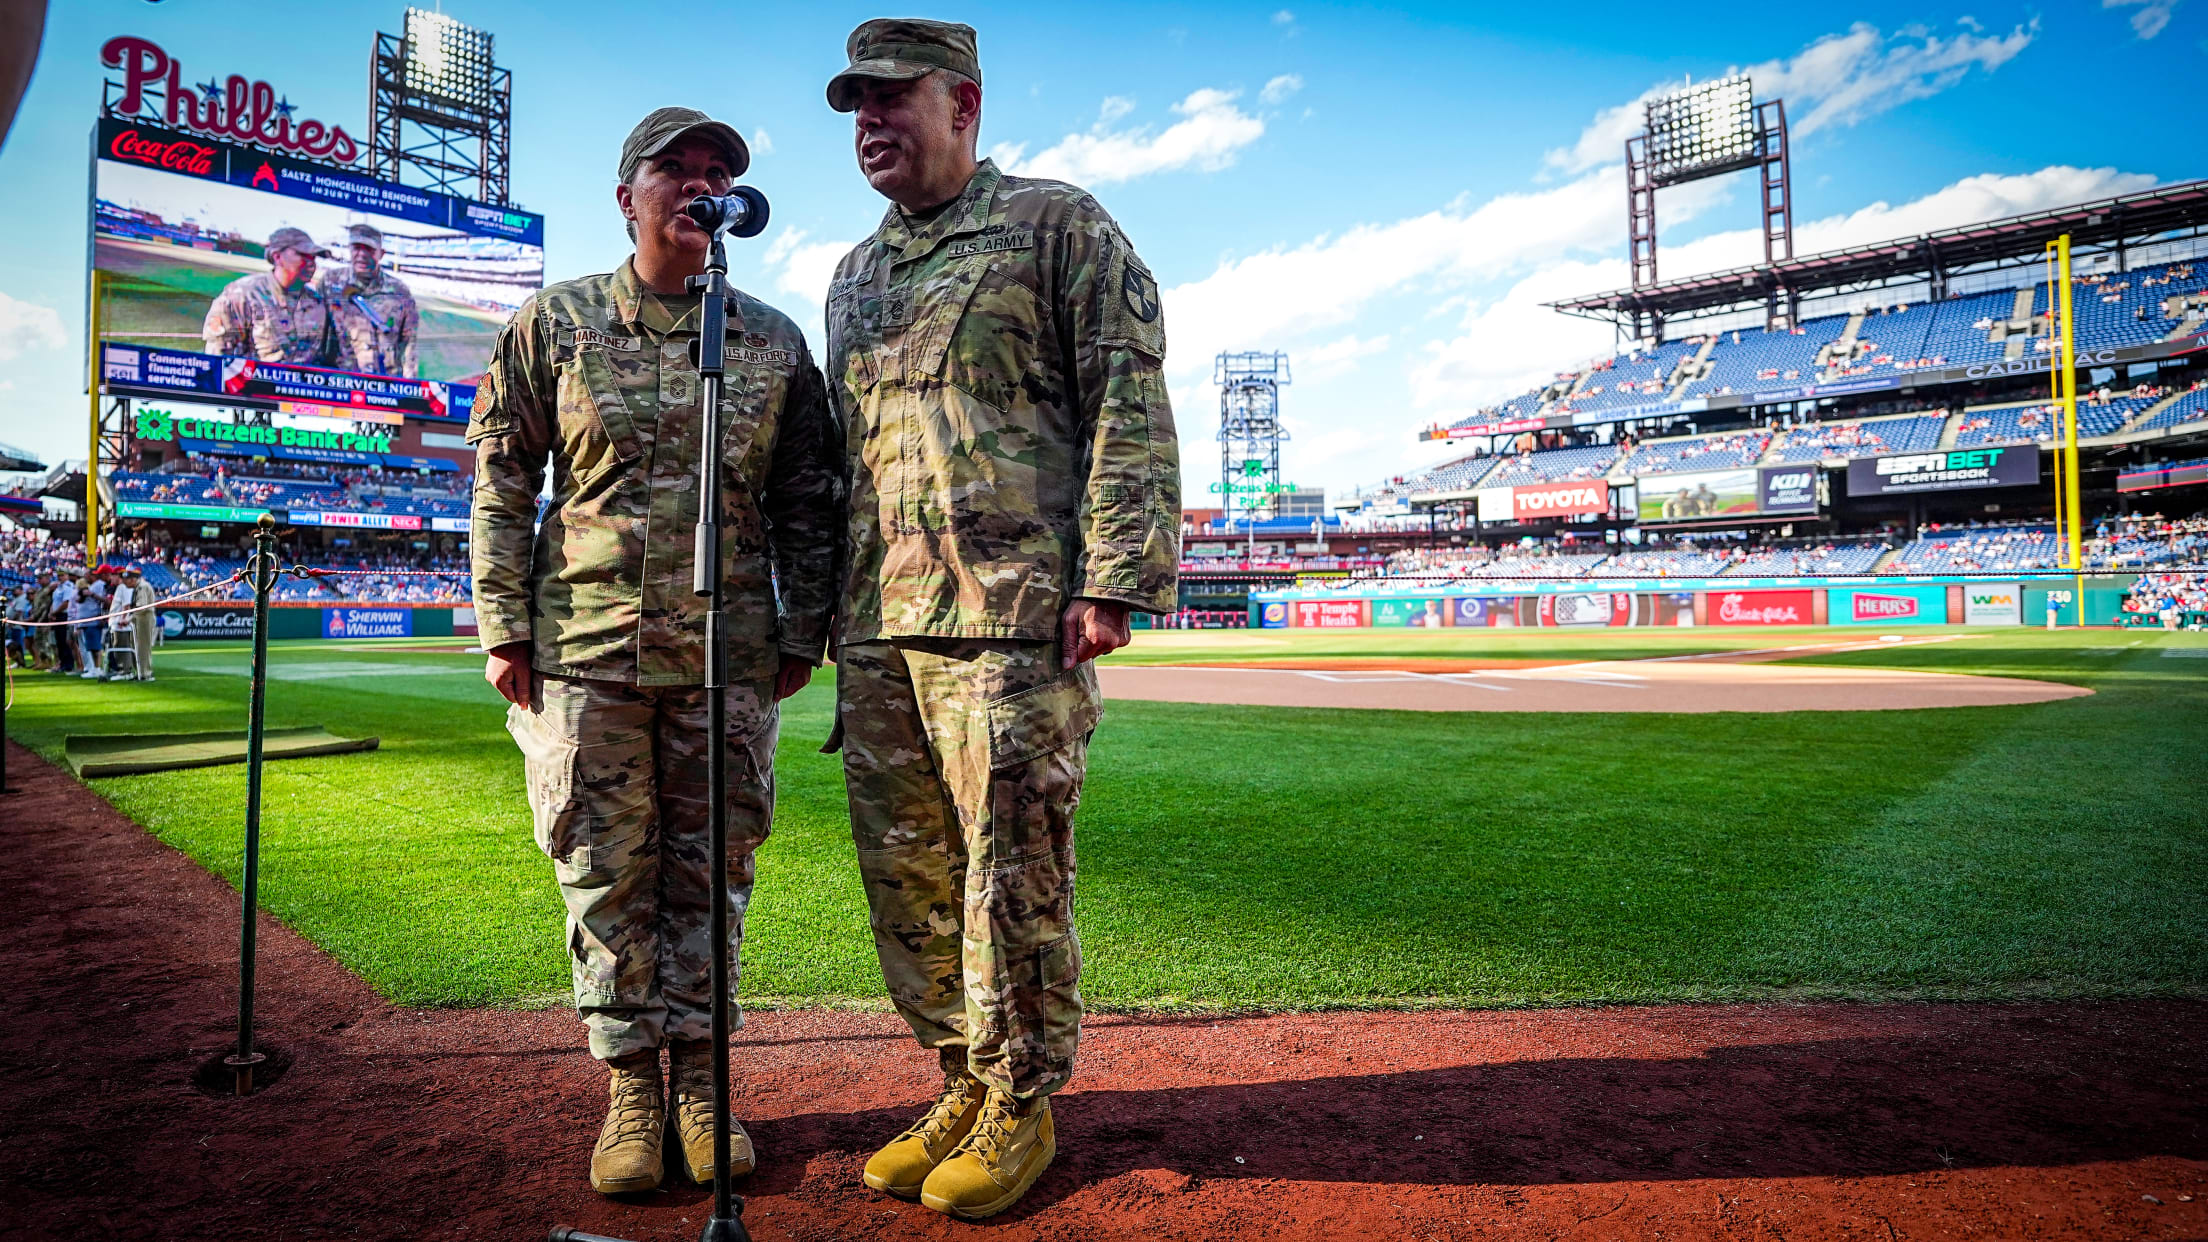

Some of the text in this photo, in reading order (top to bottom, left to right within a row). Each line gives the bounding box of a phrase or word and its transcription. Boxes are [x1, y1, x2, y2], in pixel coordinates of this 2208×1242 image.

[100, 35, 358, 164] Phillies
[281, 168, 430, 208] SALTZ MONGELUZZI BENDESKY
[311, 186, 403, 211] INJURY LAWYERS
[954, 234, 1027, 255] U.S. ARMY
[572, 331, 629, 349] MARTINEZ
[148, 352, 210, 371] Connecting
[744, 350, 760, 363] AIR
[1966, 349, 2116, 379] CADILLAC
[148, 362, 197, 378] financial
[147, 375, 197, 388] services.
[243, 367, 431, 399] SALUTE TO SERVICE NIGHT
[275, 386, 398, 406] PRESENTED BY TOYOTA
[178, 418, 391, 454] Citizens Bank Park
[1876, 449, 2005, 476] ESPN BET
[1890, 468, 1990, 485] SPORTSBOOK
[1516, 488, 1600, 511] TOYOTA
[325, 514, 359, 525] POWER
[362, 516, 388, 526] ALLEY
[347, 609, 403, 622] SHERWIN
[1320, 602, 1358, 616] Temple
[186, 612, 254, 628] NovaCare
[1320, 615, 1357, 627] Health
